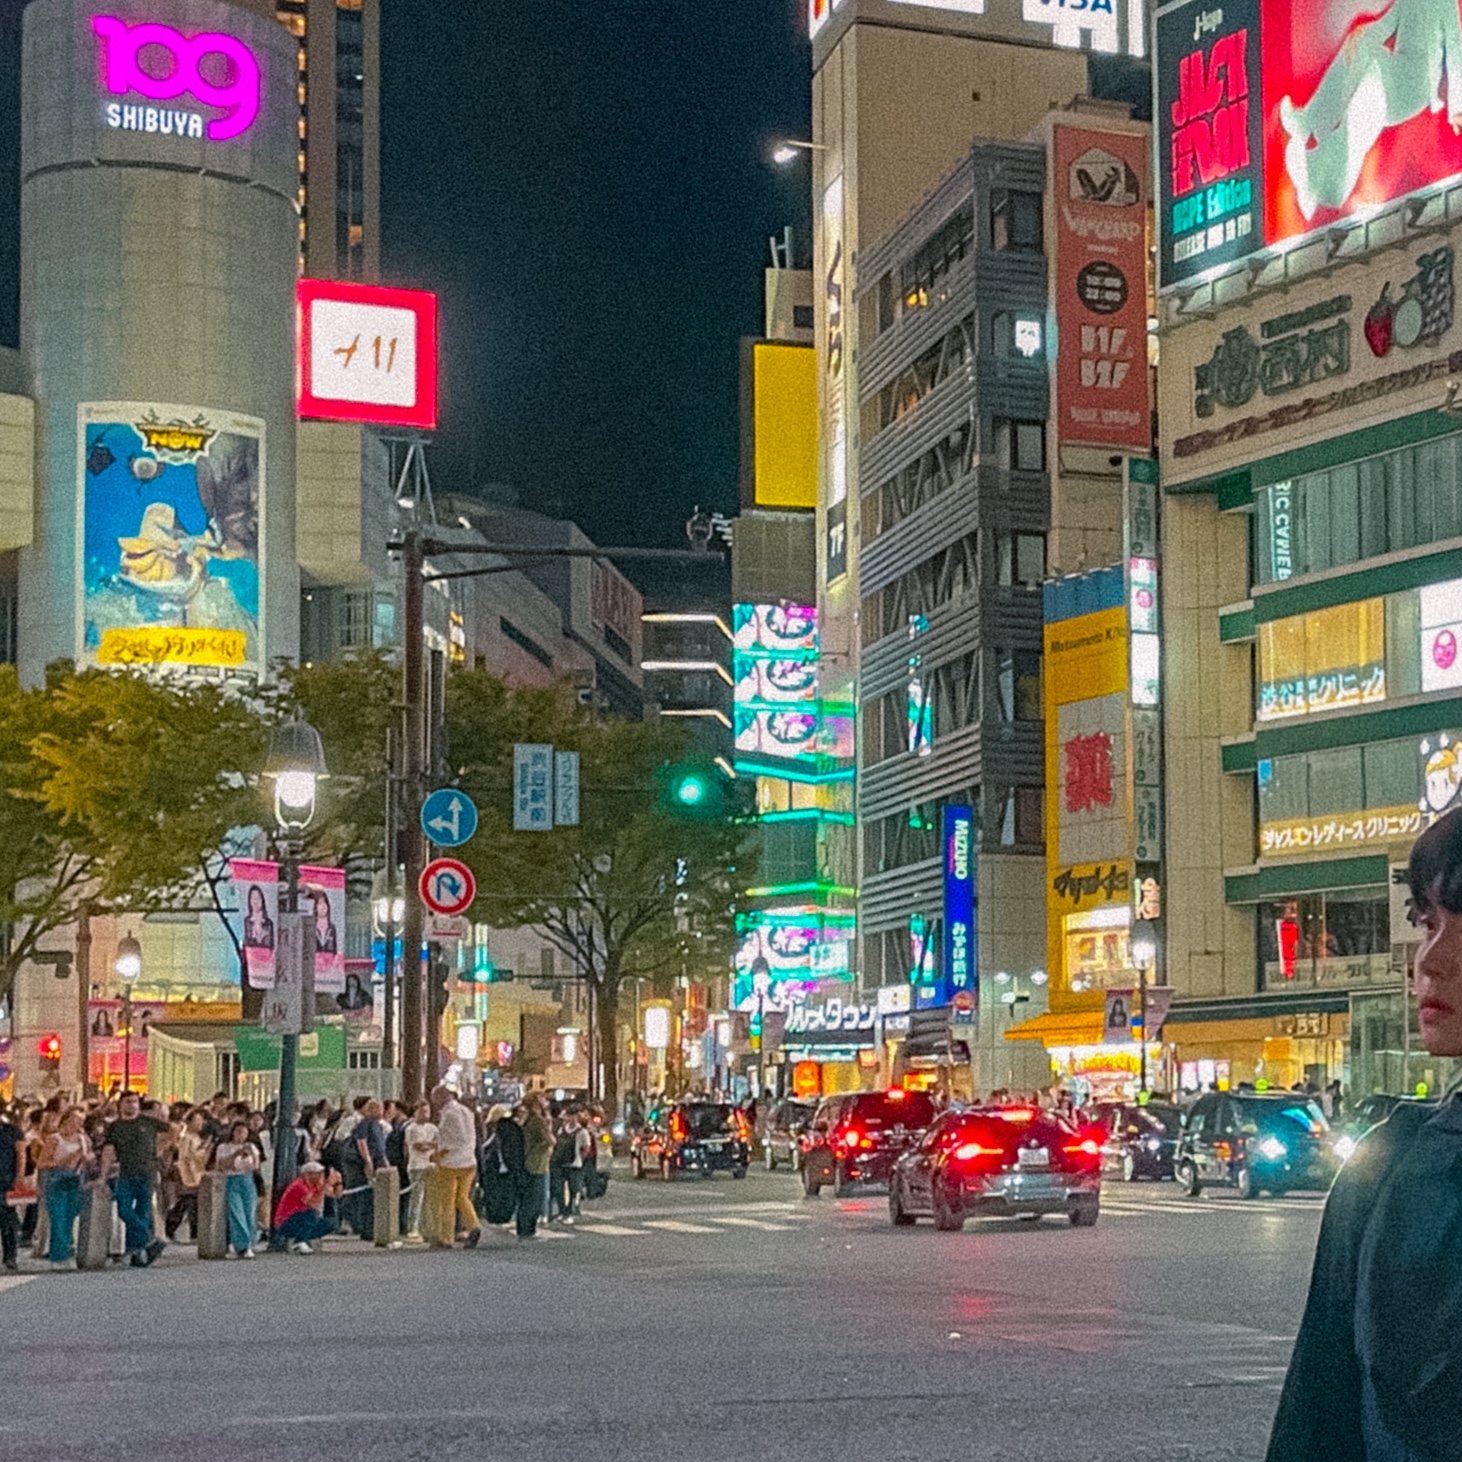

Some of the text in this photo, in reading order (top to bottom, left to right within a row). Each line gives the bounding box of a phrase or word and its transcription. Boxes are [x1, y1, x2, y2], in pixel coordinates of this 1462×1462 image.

[1042, 0, 1112, 14] ISA
[91, 15, 260, 140] 109
[106, 103, 203, 138] SHIBUYA
